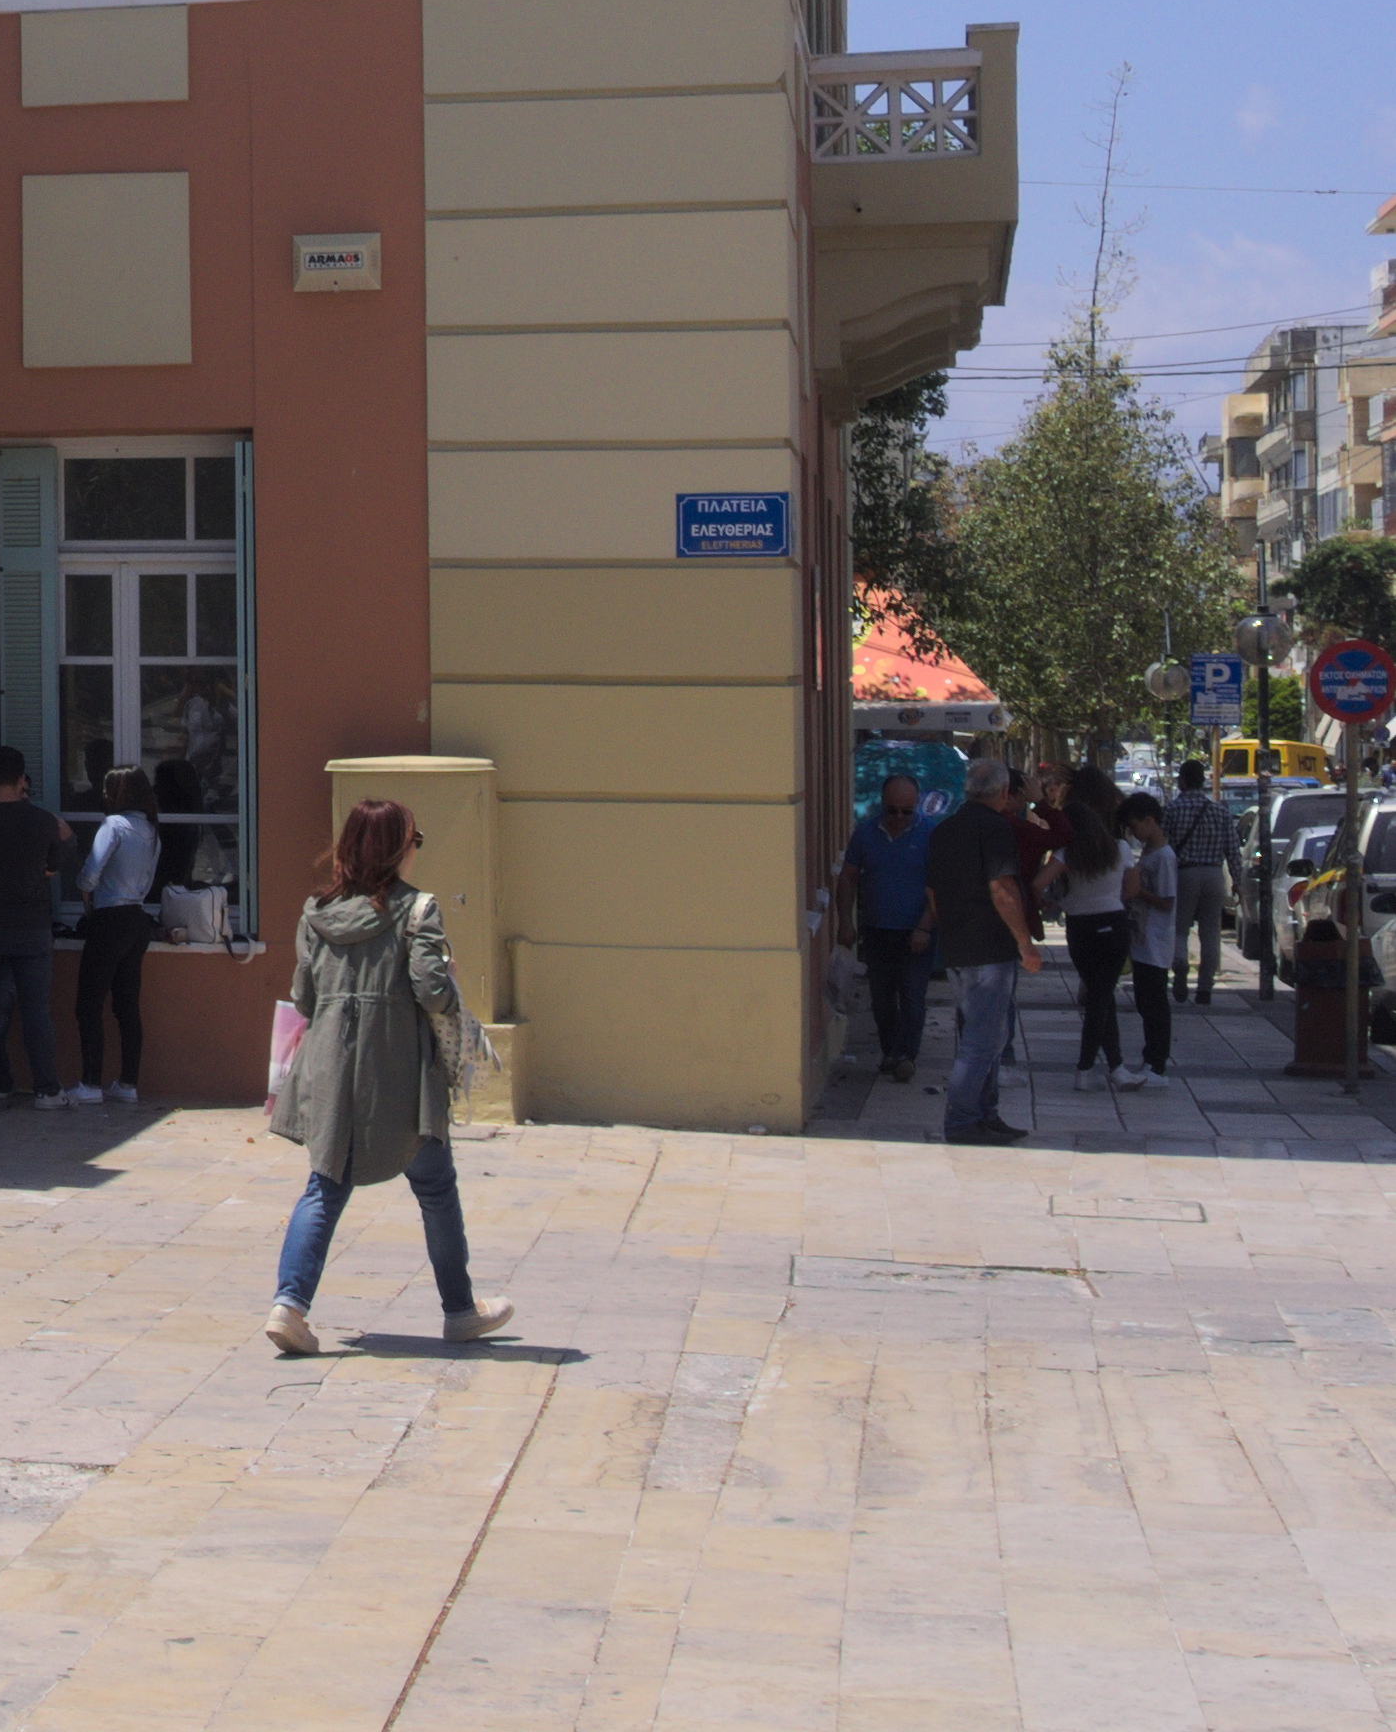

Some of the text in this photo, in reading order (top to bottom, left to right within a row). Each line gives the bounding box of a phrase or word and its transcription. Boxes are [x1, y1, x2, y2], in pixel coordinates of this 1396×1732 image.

[309, 253, 360, 264] ARMAOS
[697, 500, 767, 513] ΠΛΑΤΕΙΑ
[691, 523, 774, 537] ΕΛΕΥΘΕΡΙΑΣ
